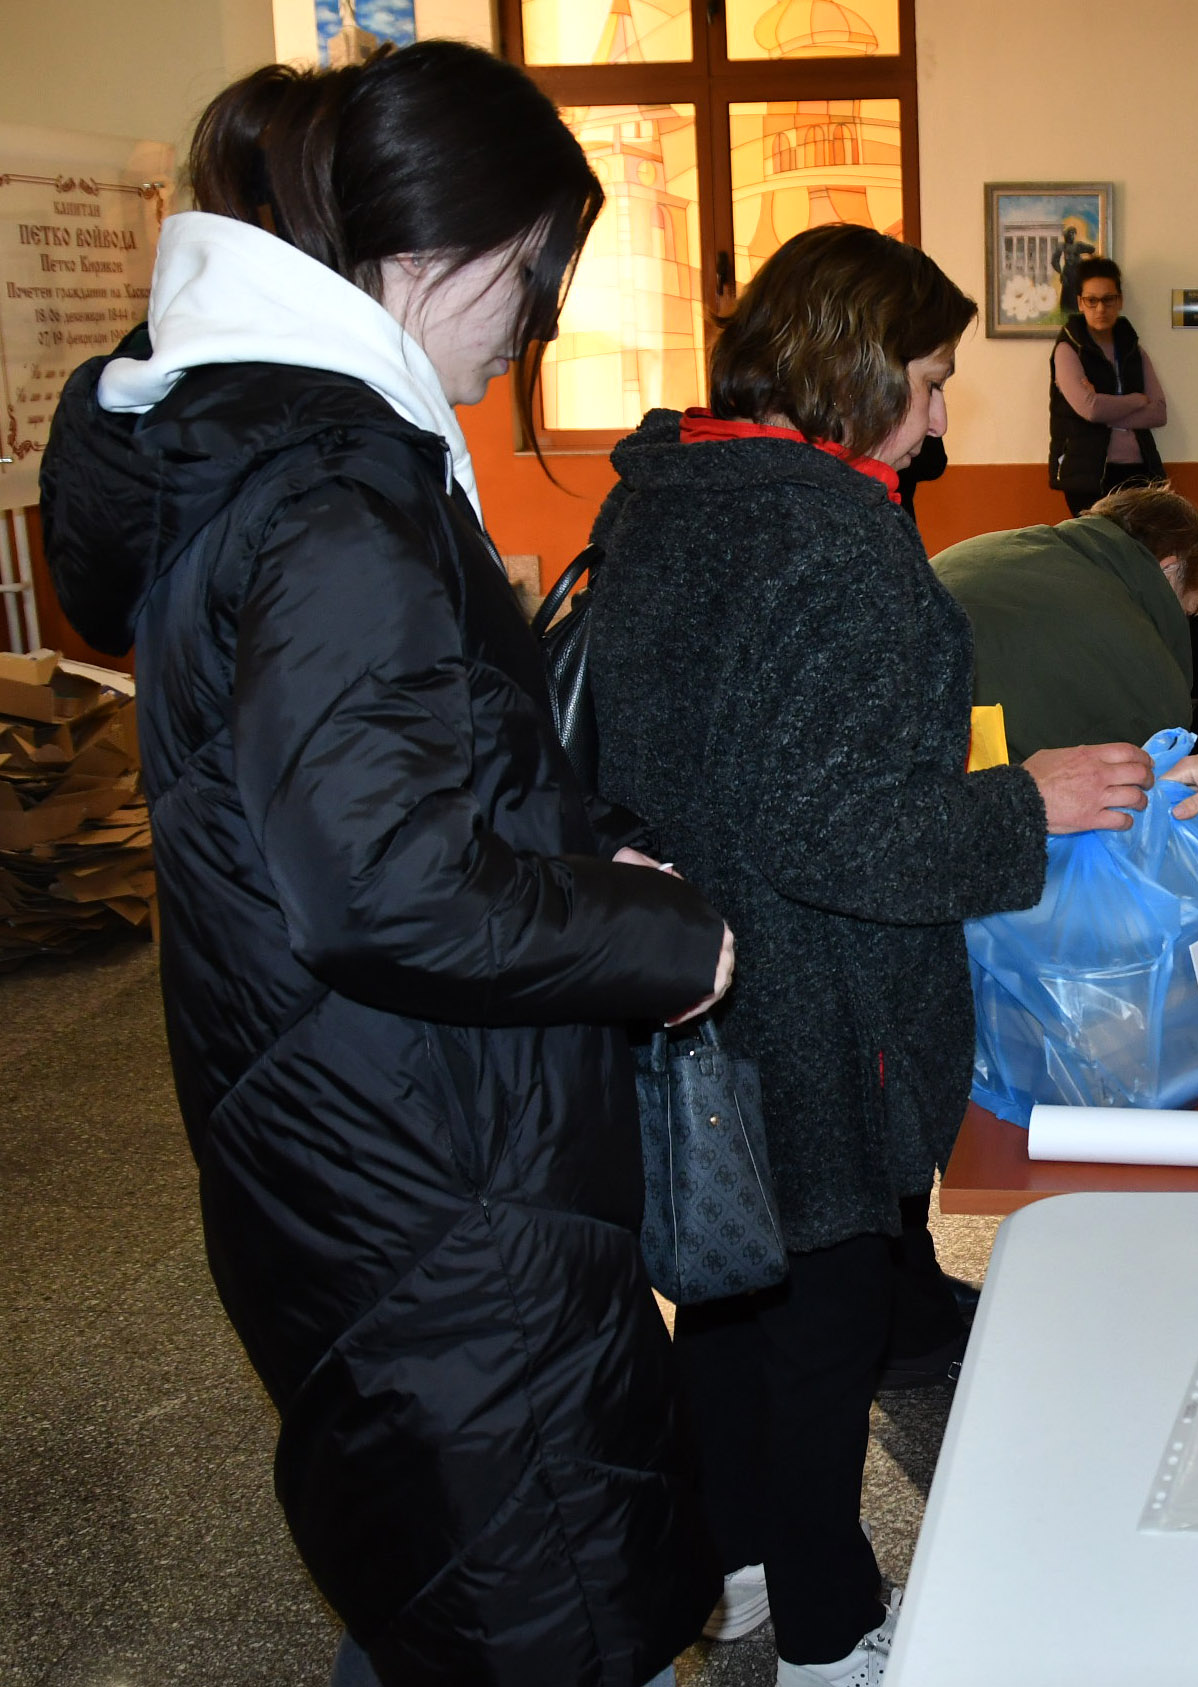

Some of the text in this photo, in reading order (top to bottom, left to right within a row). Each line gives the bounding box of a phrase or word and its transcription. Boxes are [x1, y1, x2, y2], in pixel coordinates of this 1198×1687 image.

[19, 224, 138, 250] ПЕТКО ВОЙВОДА
[41, 253, 76, 273] Петко
[7, 281, 52, 299] Почетен
